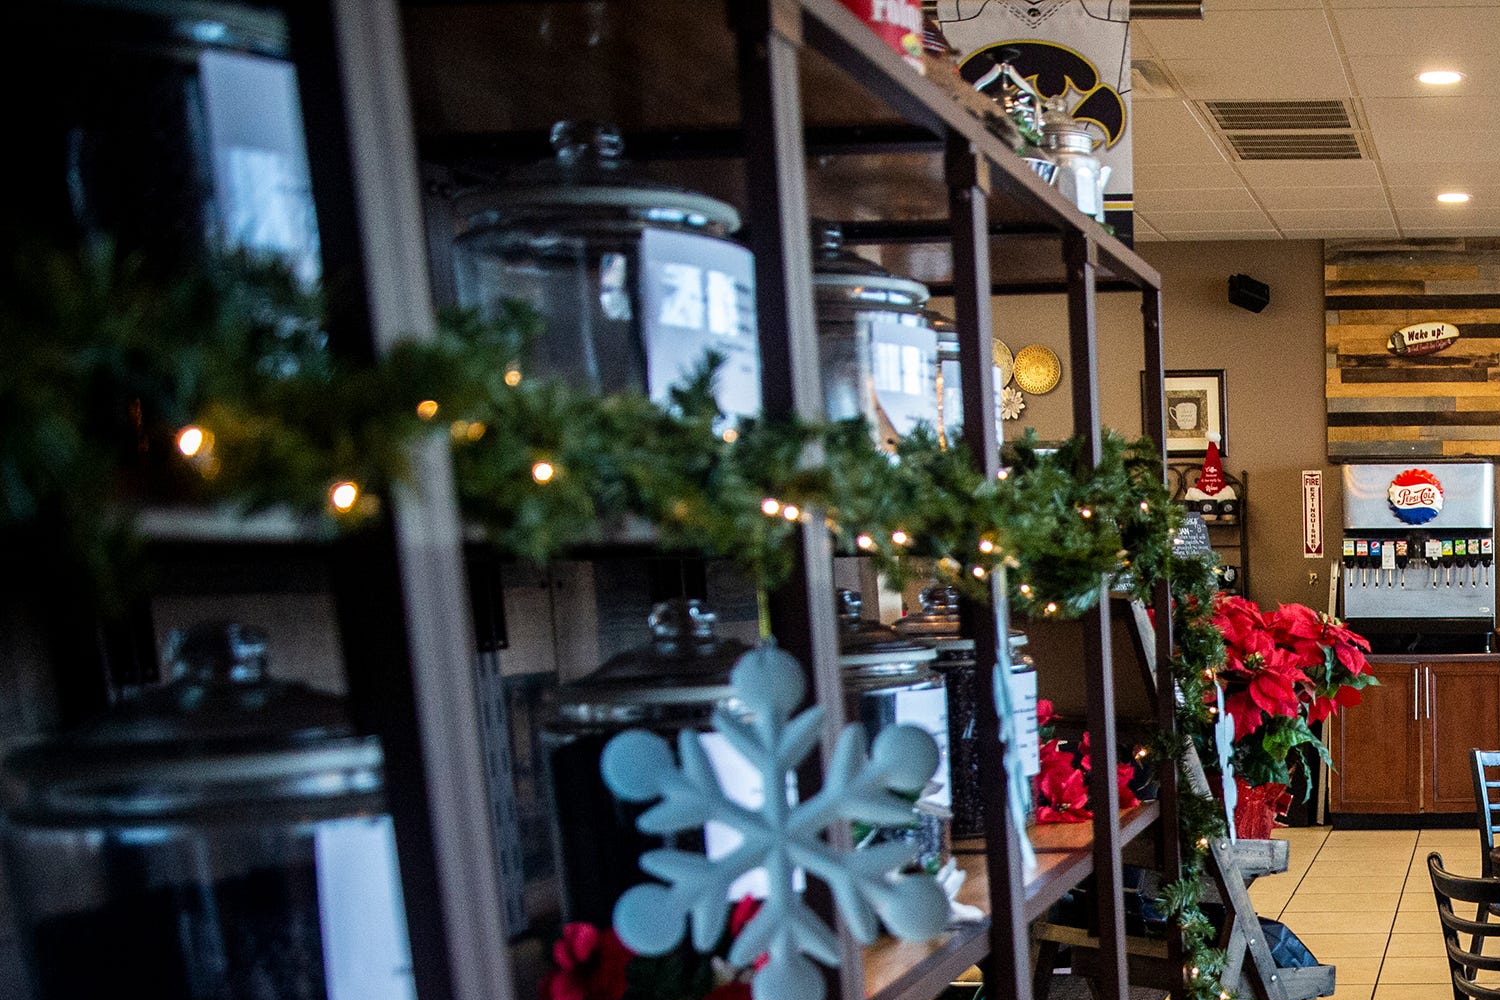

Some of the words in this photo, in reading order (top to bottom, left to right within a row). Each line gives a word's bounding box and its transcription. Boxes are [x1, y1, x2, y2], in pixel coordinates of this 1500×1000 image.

[1407, 329, 1429, 342] Wake
[1431, 324, 1445, 339] up!
[1304, 478, 1320, 486] FIRE
[1309, 487, 1317, 549] EXTINGUISHER
